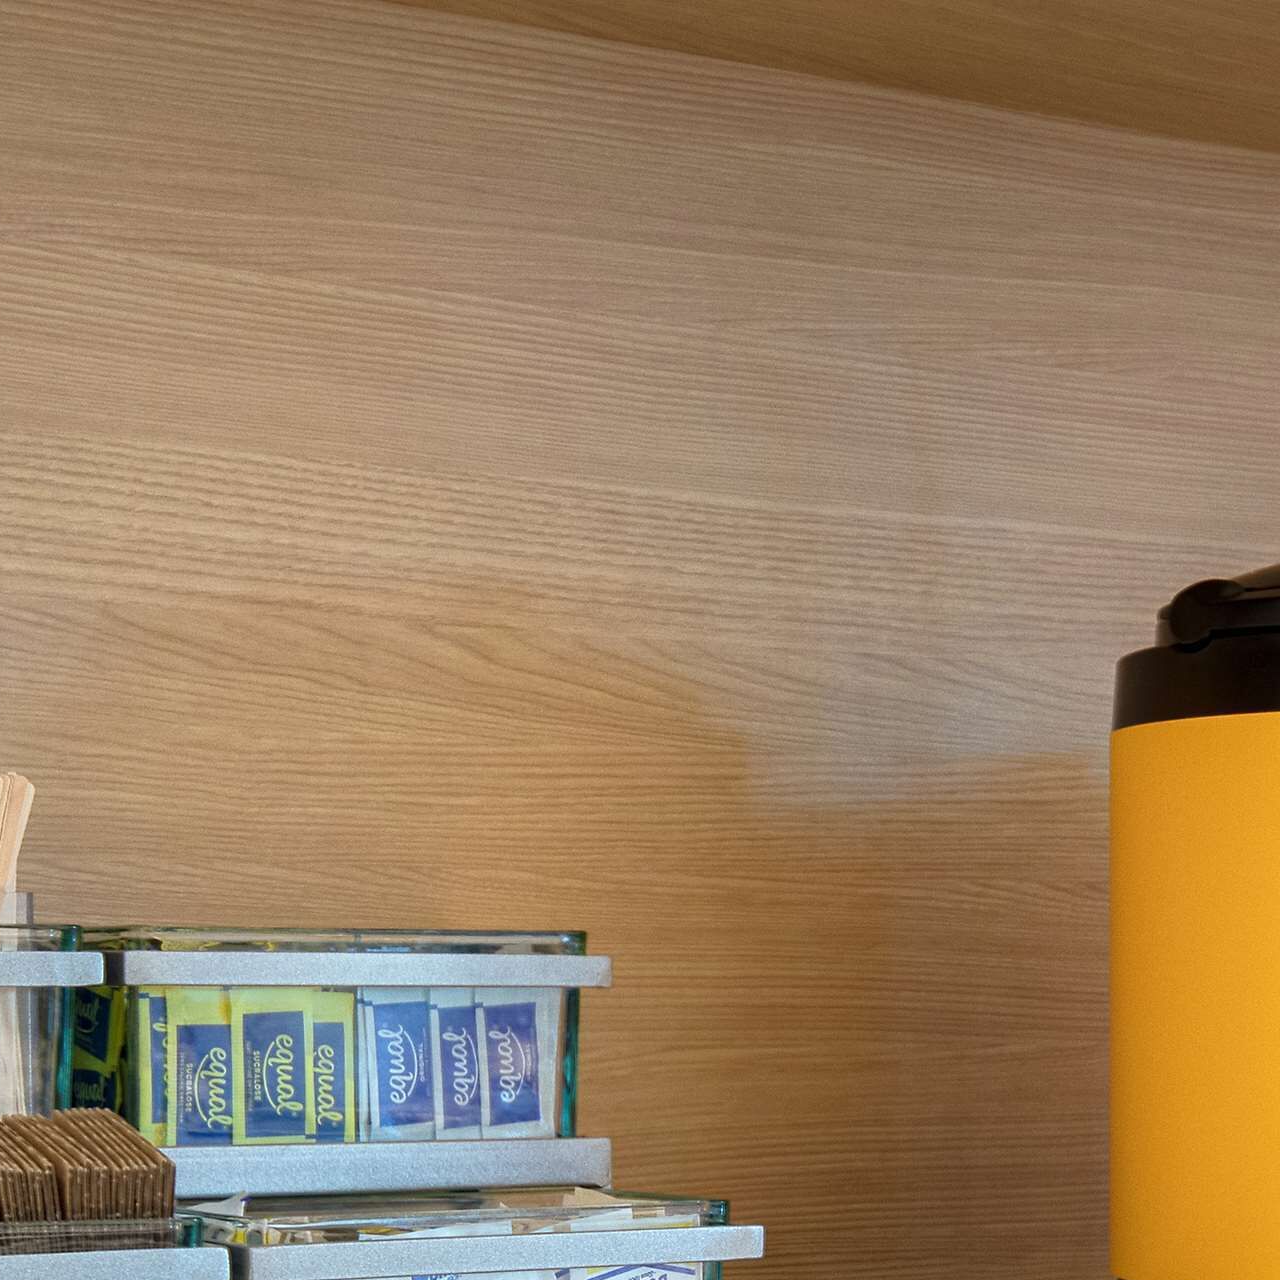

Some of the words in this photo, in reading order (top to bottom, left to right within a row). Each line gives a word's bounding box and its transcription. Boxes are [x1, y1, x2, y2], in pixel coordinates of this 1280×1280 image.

[201, 1047, 233, 1129] equal
[253, 1050, 262, 1101] SUCRALOSE
[268, 1034, 304, 1116] equal
[313, 1044, 344, 1126] equal
[378, 1024, 414, 1104] equal
[442, 1028, 475, 1107] equal
[488, 1025, 522, 1103] equal
